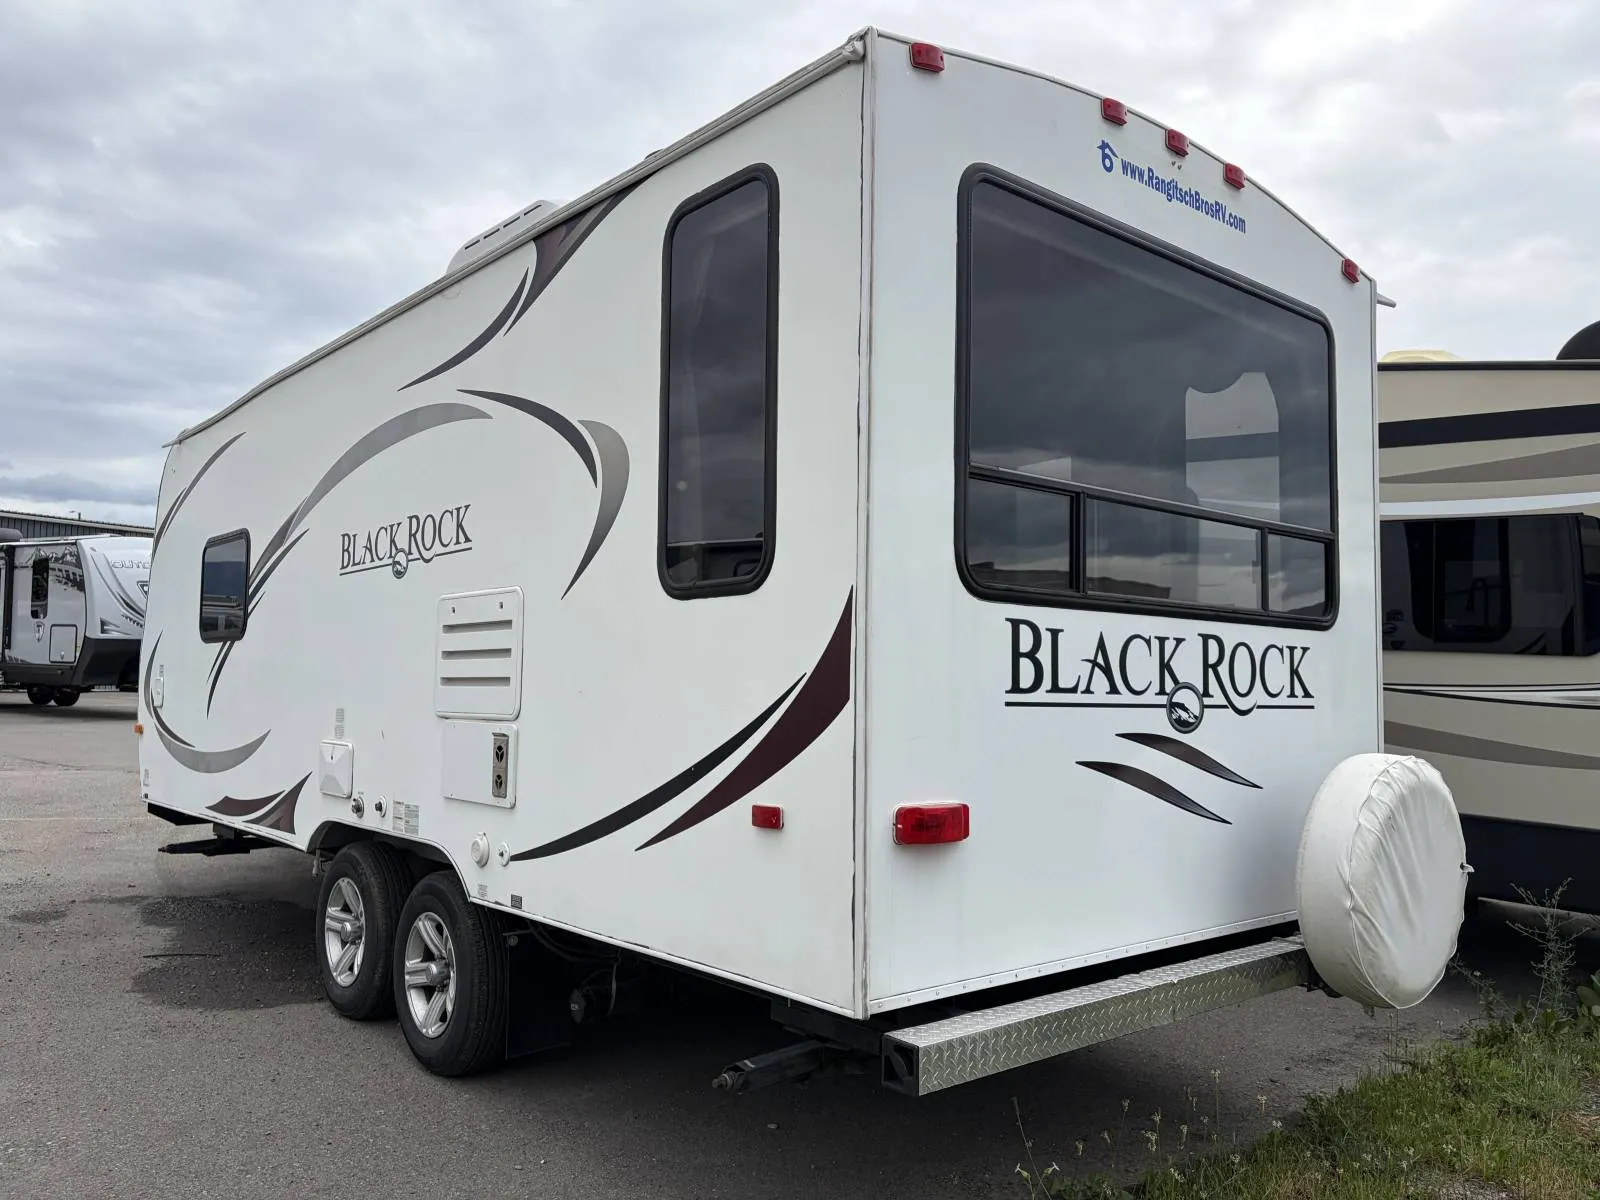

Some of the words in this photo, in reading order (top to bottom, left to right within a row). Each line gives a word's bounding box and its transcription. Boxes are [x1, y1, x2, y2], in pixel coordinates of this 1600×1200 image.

[1121, 158, 1246, 233] www.RangitschBrosRV.com
[340, 522, 402, 570] BLACK
[407, 504, 472, 563] ROCK
[1005, 617, 1186, 696] BLACK
[1198, 633, 1314, 716] ROCK
